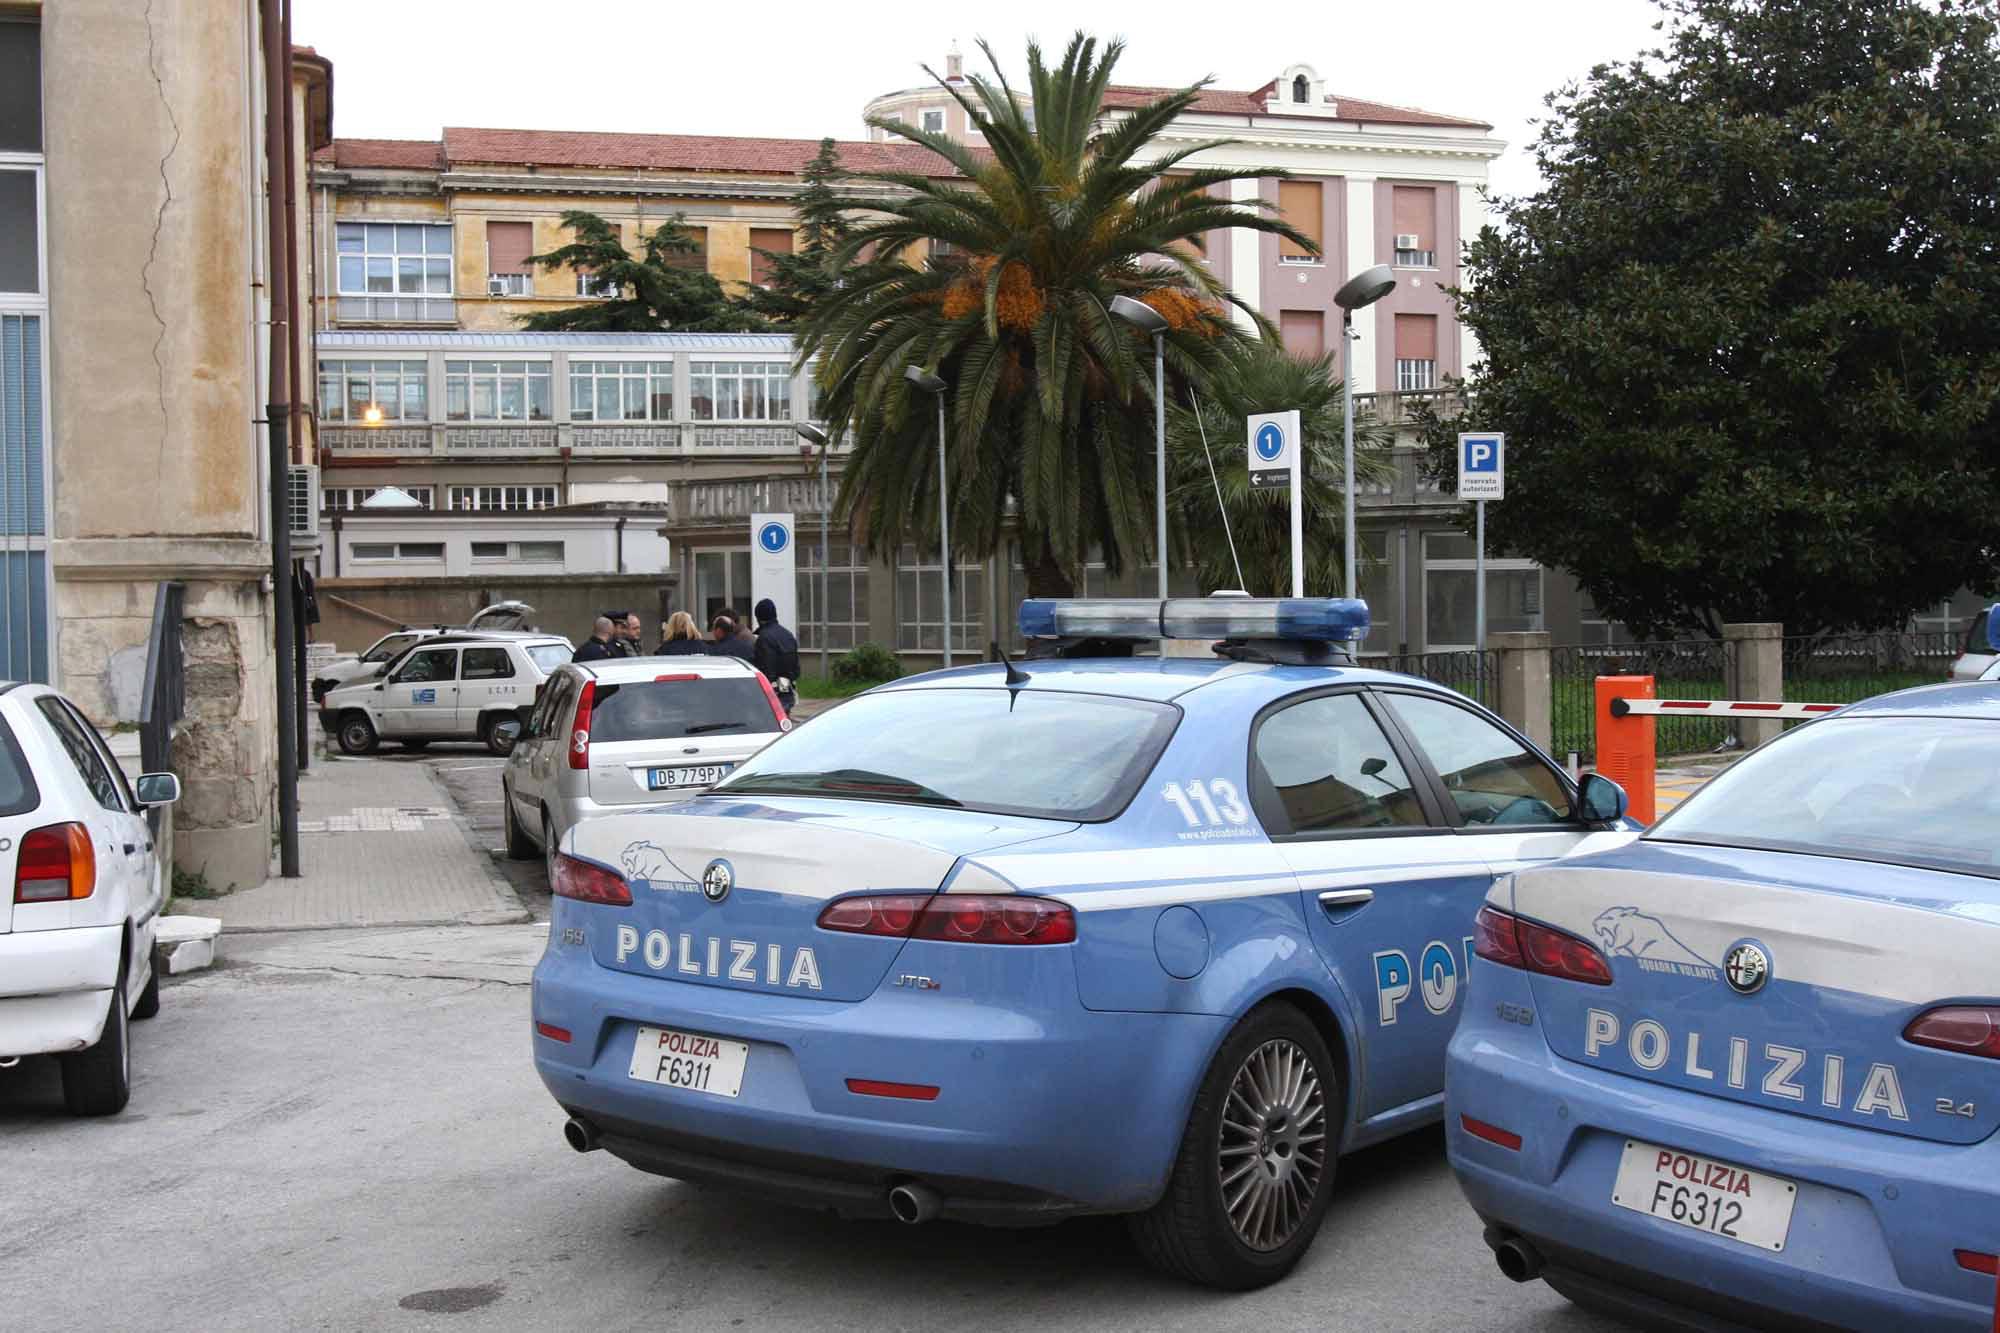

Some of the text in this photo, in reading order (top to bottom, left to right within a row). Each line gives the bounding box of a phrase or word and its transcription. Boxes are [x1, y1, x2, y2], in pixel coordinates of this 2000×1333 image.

[1471, 444, 1491, 468] P
[658, 770, 676, 785] DB
[1160, 777, 1249, 829] 113
[616, 924, 823, 990] POLIZIA
[1373, 935, 1475, 1027] PO
[658, 1031, 720, 1060] POLIZIA
[1584, 1007, 1910, 1121] POLIZIA
[656, 1055, 712, 1090] F6311
[1656, 1151, 1751, 1197] POLIZIA
[1651, 1180, 1742, 1237] F6312
